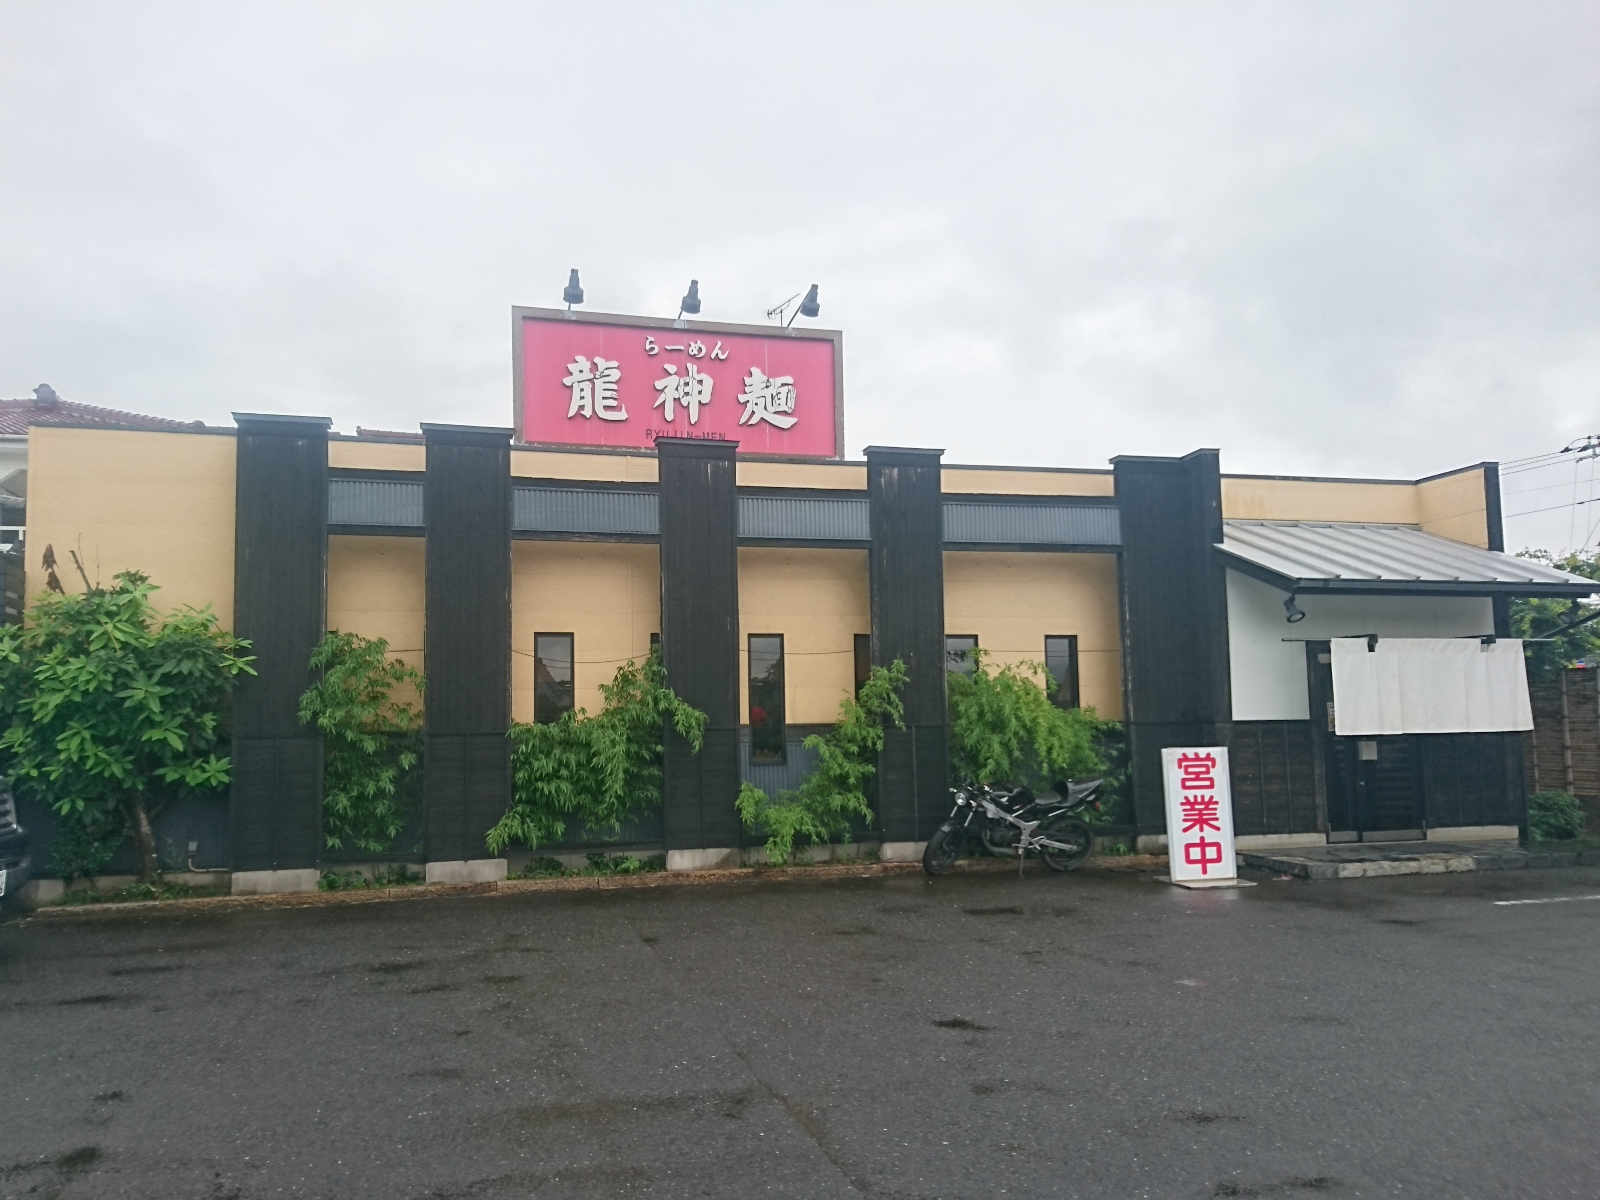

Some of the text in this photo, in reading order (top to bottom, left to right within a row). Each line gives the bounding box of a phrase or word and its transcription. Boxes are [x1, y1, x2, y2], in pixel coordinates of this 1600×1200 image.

[645, 335, 730, 360] らーめん
[1176, 752, 1223, 875] 営業中
